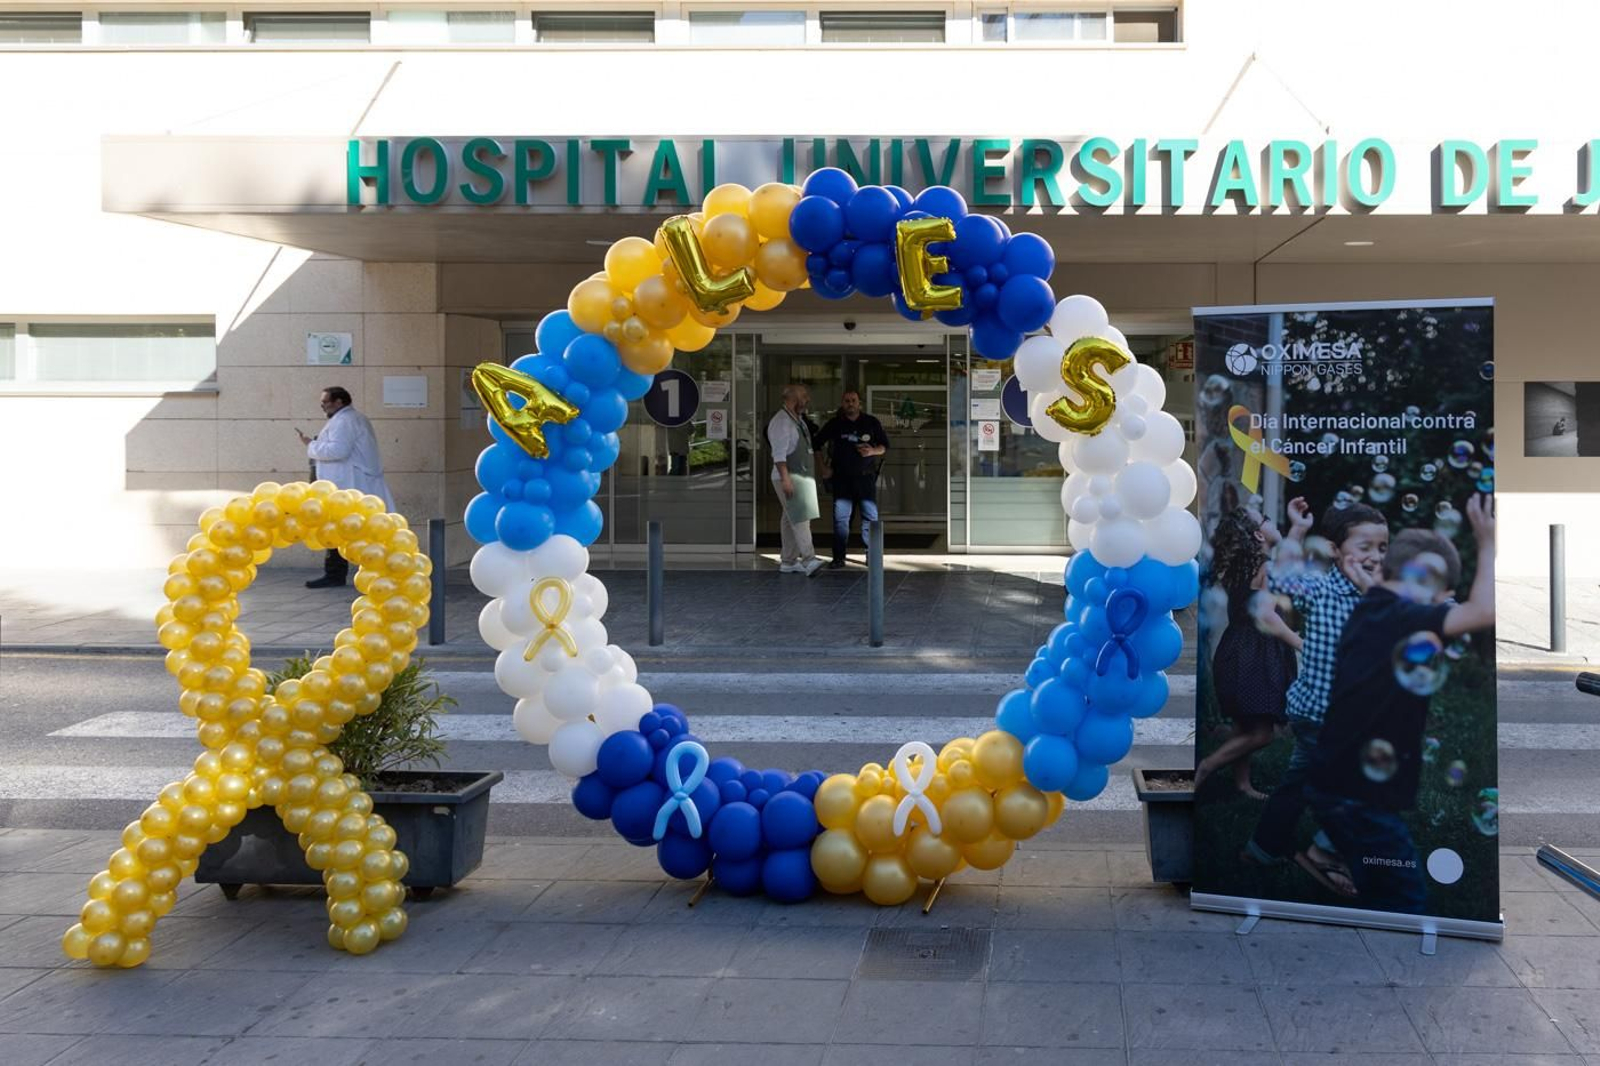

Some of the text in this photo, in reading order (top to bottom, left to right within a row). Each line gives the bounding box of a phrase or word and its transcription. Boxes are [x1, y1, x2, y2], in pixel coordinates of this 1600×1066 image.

[782, 136, 1396, 208] UNIVERSITARIO
[1441, 138, 1539, 207] DE
[1261, 343, 1362, 361] OXIMESA
[1260, 362, 1363, 376] NIPPON GASES
[660, 379, 680, 418] 1
[1250, 412, 1476, 430] Día Internacional contra
[1251, 437, 1408, 455] el Cáncer Infantil
[1362, 855, 1417, 869] oximesa.es
